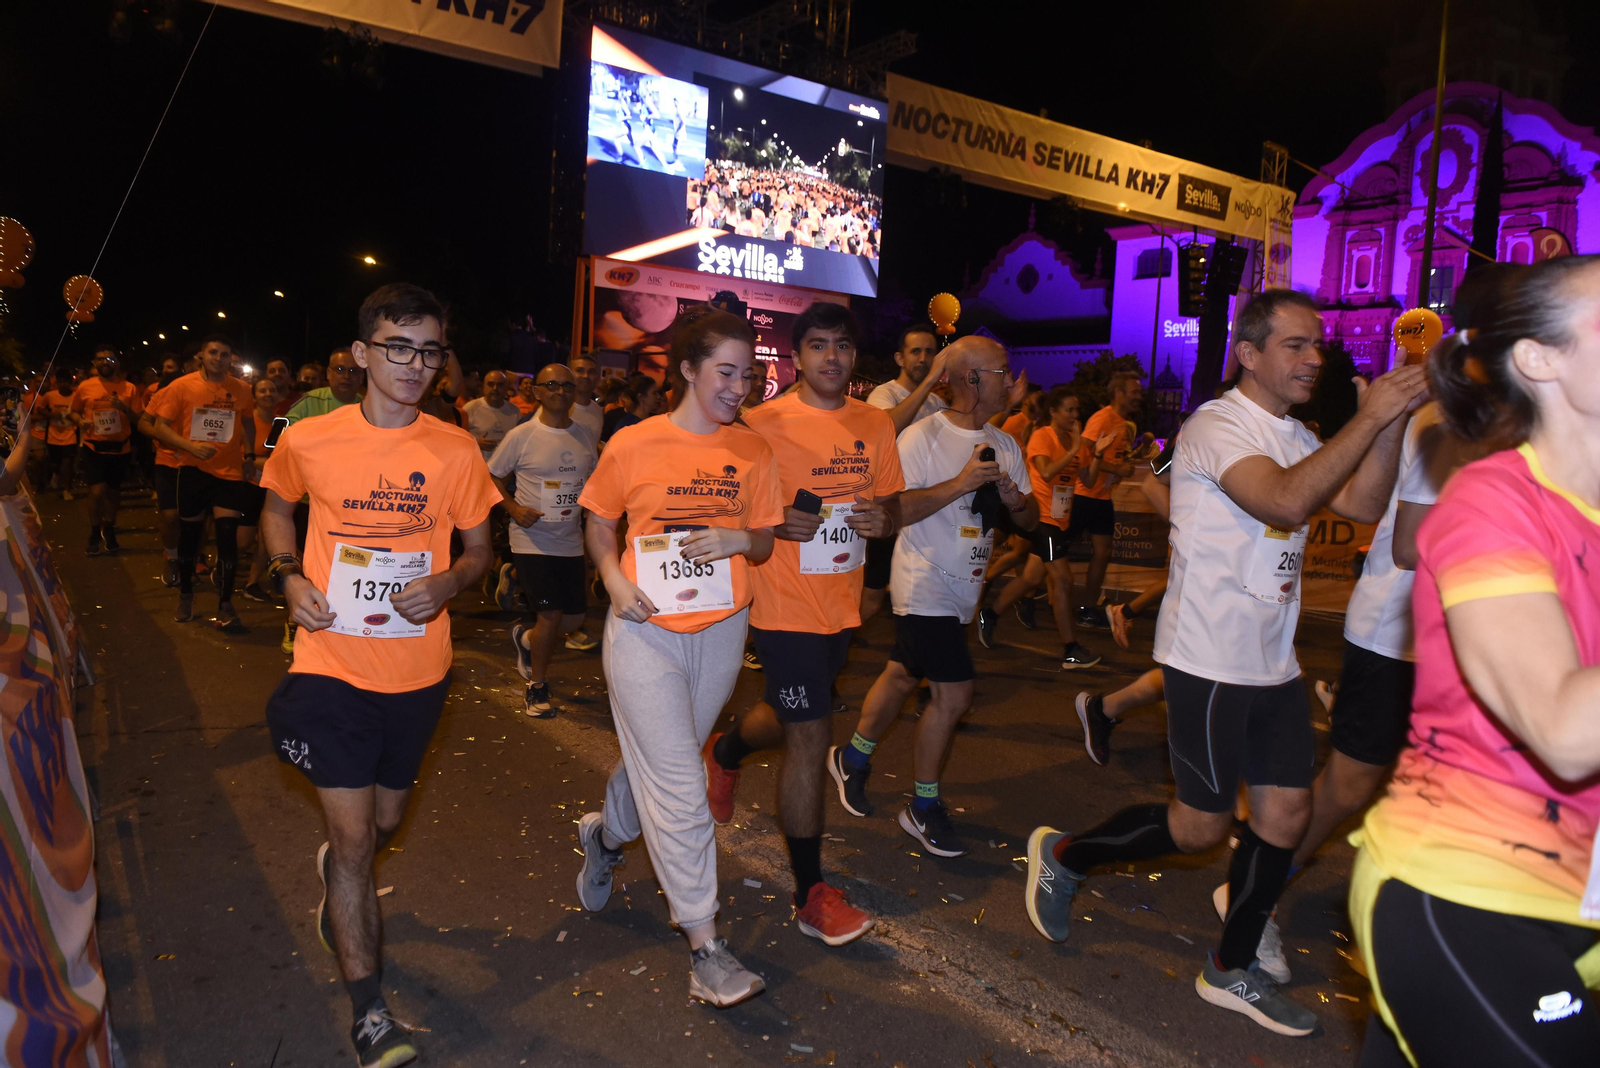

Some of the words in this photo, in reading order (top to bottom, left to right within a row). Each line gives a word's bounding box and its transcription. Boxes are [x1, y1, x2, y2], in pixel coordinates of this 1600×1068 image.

[893, 102, 1027, 161] NOCTURNA
[1032, 141, 1119, 186] SEVILLA
[647, 275, 663, 285] ABC
[669, 279, 701, 292] Cruzcampo
[203, 418, 224, 429] 6652
[829, 456, 870, 465] NOCTURNA
[558, 465, 577, 473] Cenit
[811, 466, 849, 476] SEVILLA
[691, 478, 741, 489] NOCTURNA
[369, 490, 428, 503] NOCTURNA
[666, 486, 715, 497] SEVILLA
[342, 498, 395, 512] SEVILLA
[659, 559, 715, 580] 13685
[1303, 570, 1351, 581] eportes
